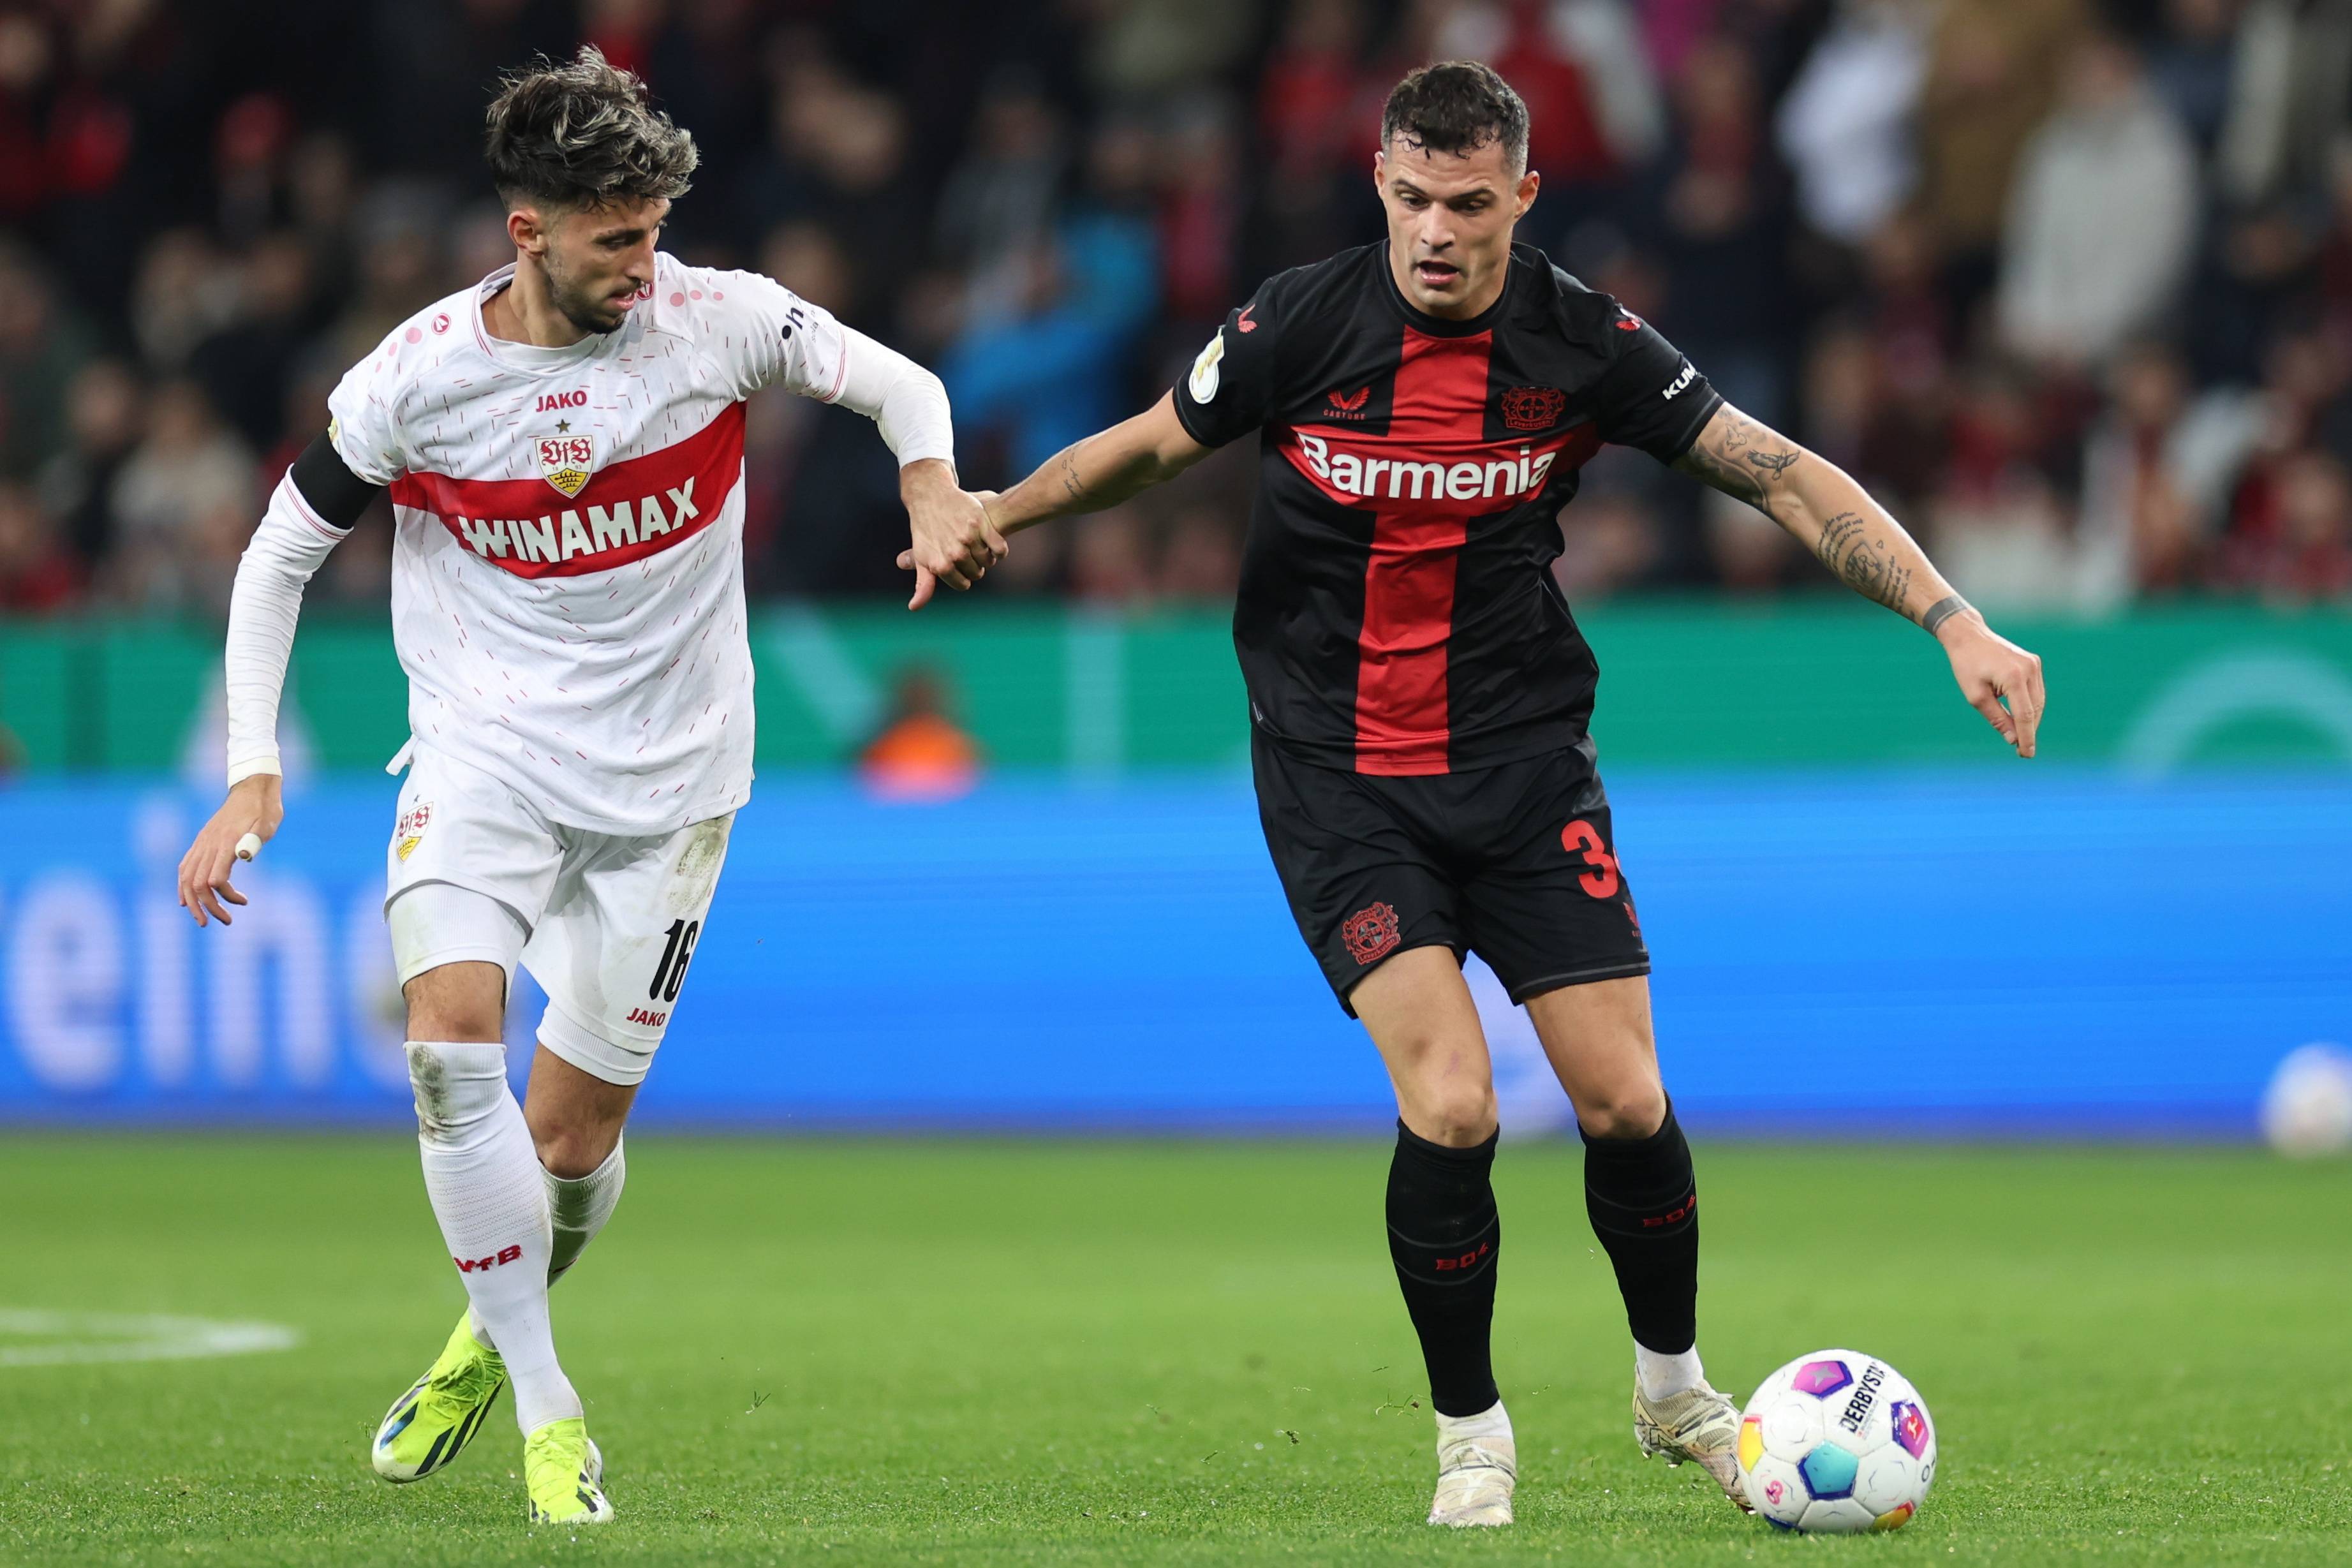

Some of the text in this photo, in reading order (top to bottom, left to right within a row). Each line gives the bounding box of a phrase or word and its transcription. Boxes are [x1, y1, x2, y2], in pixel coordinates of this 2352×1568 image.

[536, 390, 587, 412] JAKO
[1662, 362, 1697, 400] KUM
[1298, 432, 1557, 500] Barmenia
[457, 475, 700, 563] WINAMAX
[1561, 819, 1622, 899] 3
[649, 919, 699, 1002] 16
[626, 1007, 666, 1027] JAKO
[454, 1245, 524, 1273] VfB
[1838, 1361, 1886, 1434] DERBYSTA
